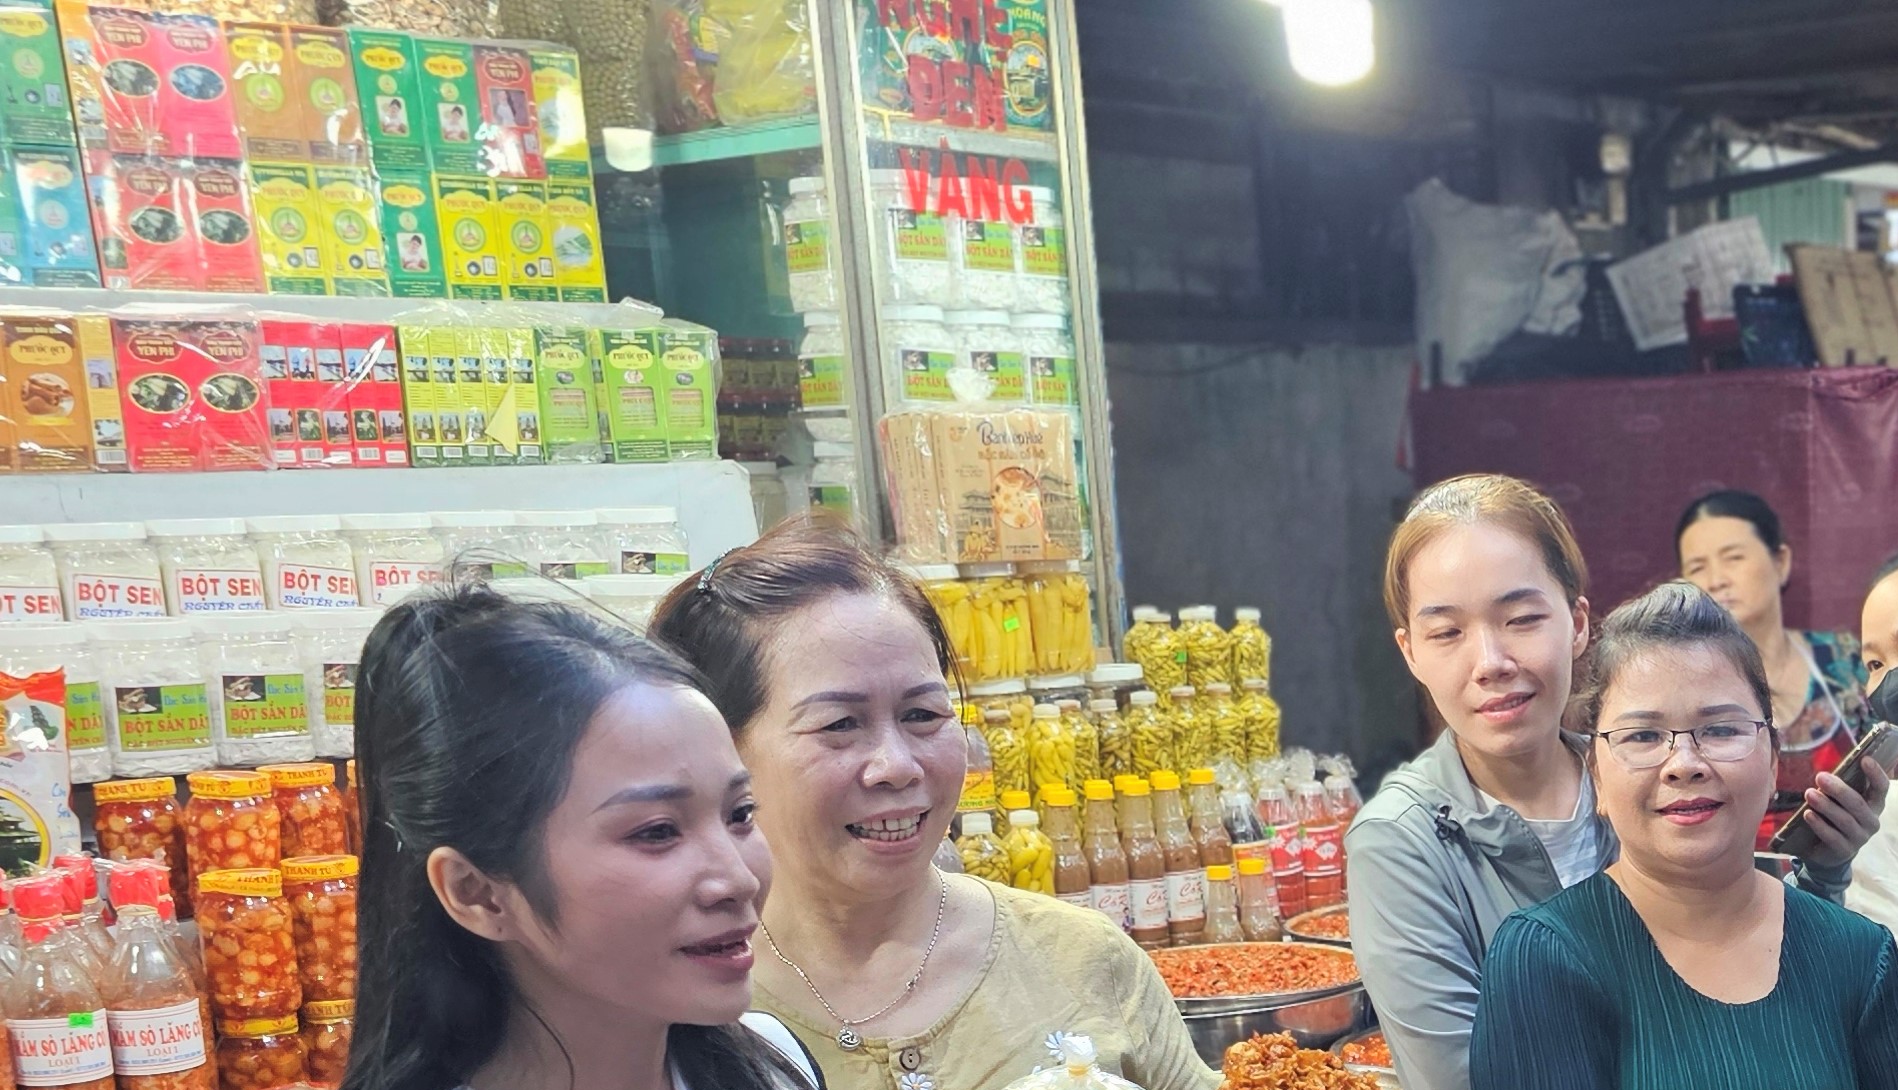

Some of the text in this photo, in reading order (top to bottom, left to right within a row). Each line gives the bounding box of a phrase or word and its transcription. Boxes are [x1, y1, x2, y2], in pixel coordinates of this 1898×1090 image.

[897, 136, 1035, 225] VÀNG
[78, 579, 163, 608] BỘT SEN
[182, 573, 262, 601] BỘT SEN
[284, 569, 322, 595] BỘT
[24, 594, 61, 615] SEN
[231, 705, 257, 725] BỘT
[125, 719, 153, 738] BỘT
[285, 865, 318, 877] THANH
